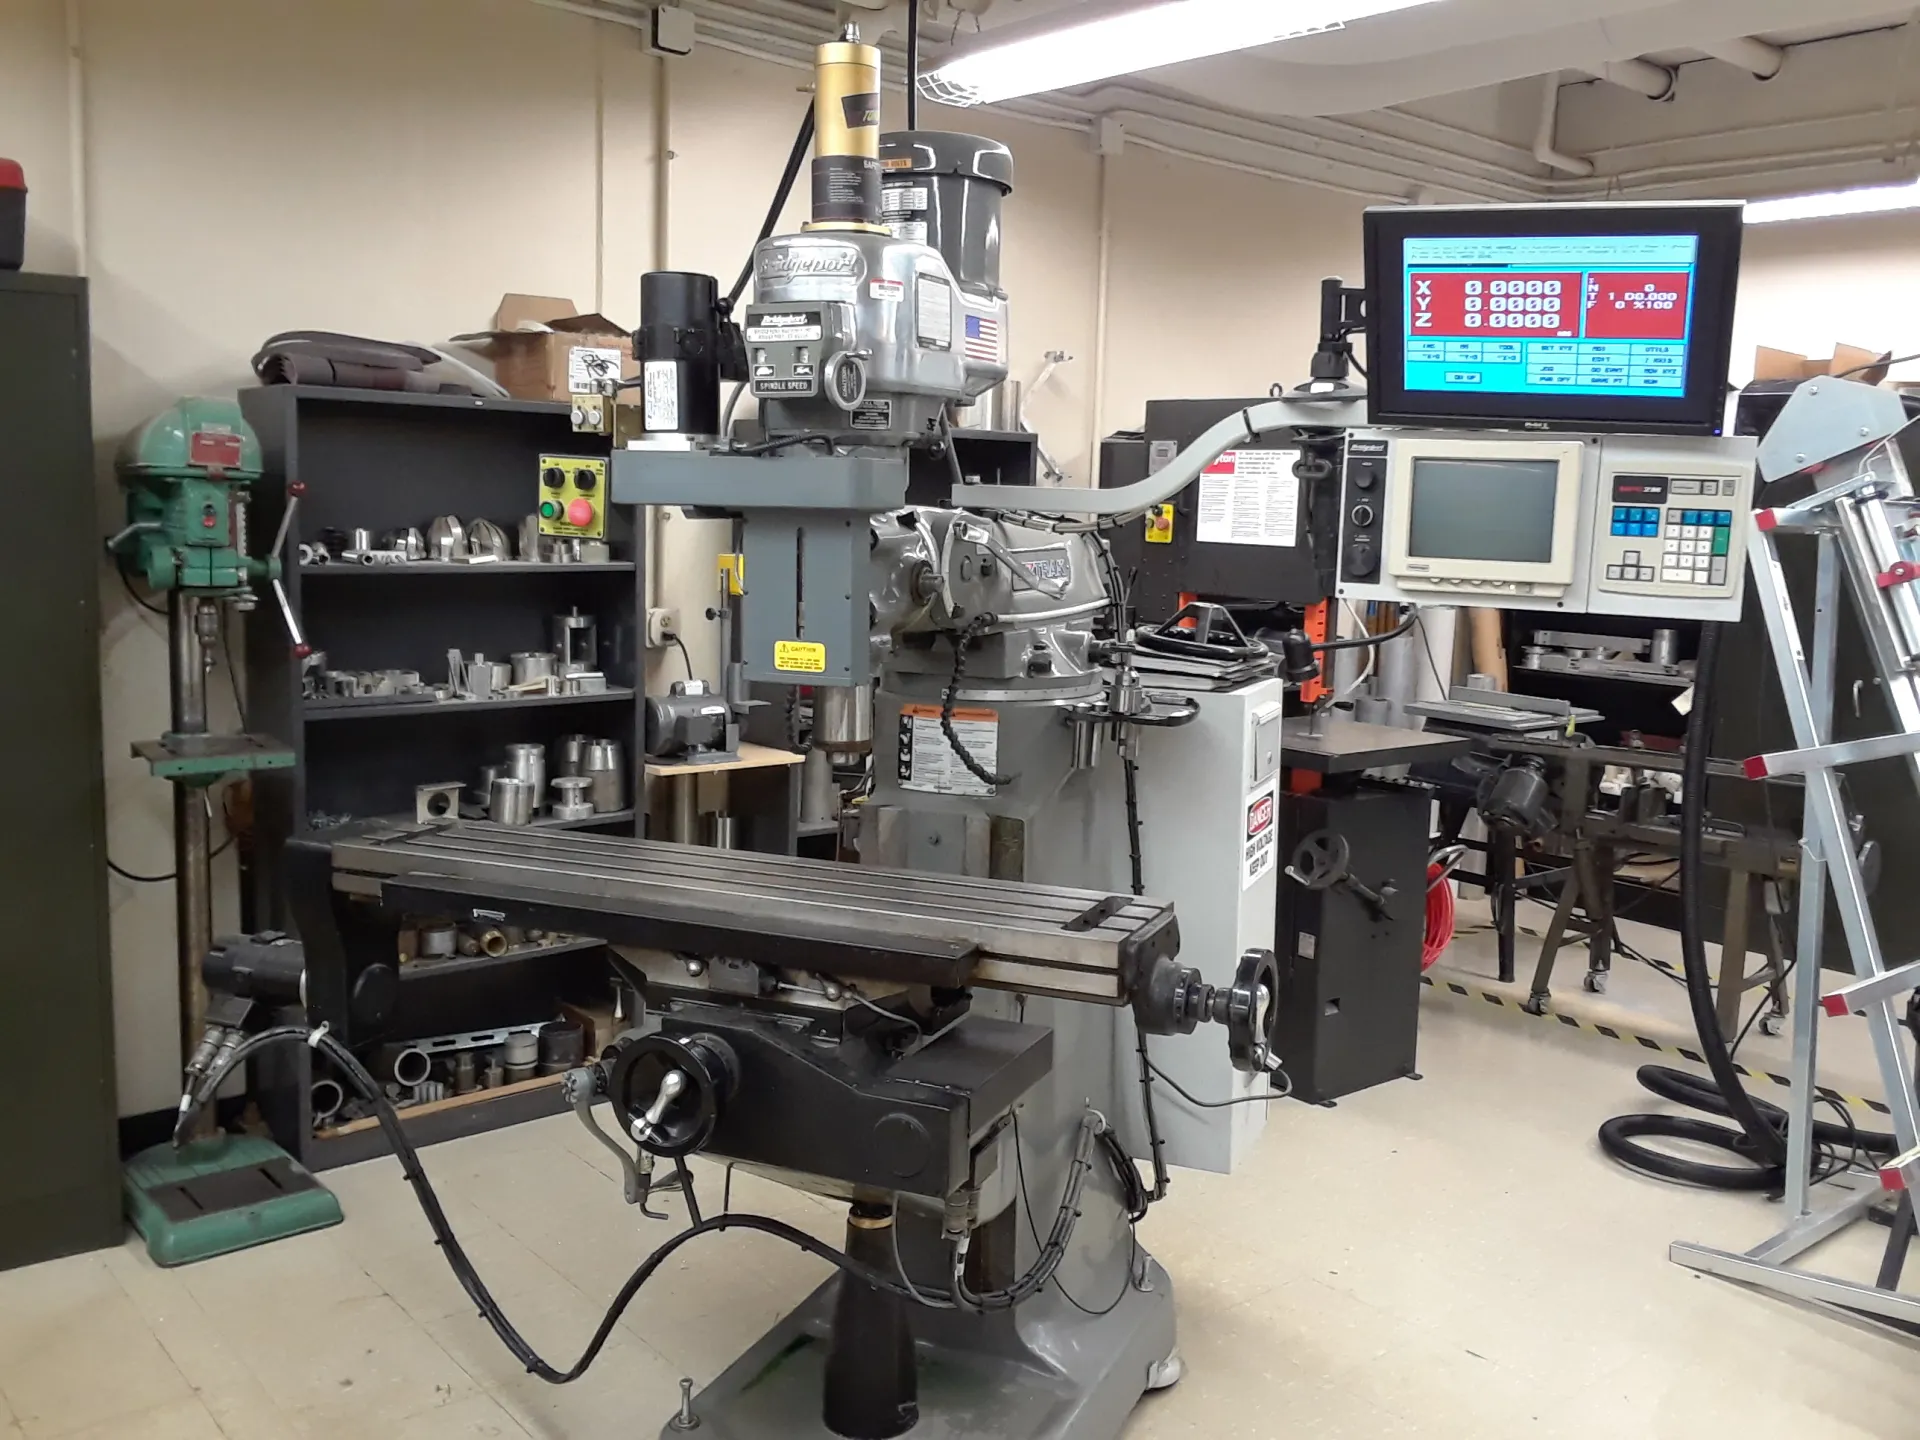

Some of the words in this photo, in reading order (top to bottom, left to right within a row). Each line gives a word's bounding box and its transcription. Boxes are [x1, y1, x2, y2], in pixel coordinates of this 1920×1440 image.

[1415, 280, 1432, 295] X
[1464, 280, 1562, 295] 0.0000
[1588, 283, 1599, 292] N
[1644, 283, 1655, 292] 0
[1587, 292, 1598, 300] T
[1415, 296, 1432, 311] Y
[1464, 296, 1561, 312] 0.0000
[1587, 300, 1597, 309] F
[1614, 301, 1625, 309] 0
[1415, 312, 1432, 327] Z
[1464, 313, 1560, 328] 0.0000
[760, 381, 786, 391] SPINDLE
[788, 381, 808, 390] SPEED
[1249, 802, 1272, 829] DANGER
[1245, 842, 1256, 861] HIGH
[1256, 829, 1273, 852] VOLTAGE
[1249, 857, 1260, 876] KEEP
[1260, 850, 1269, 869] OUT
